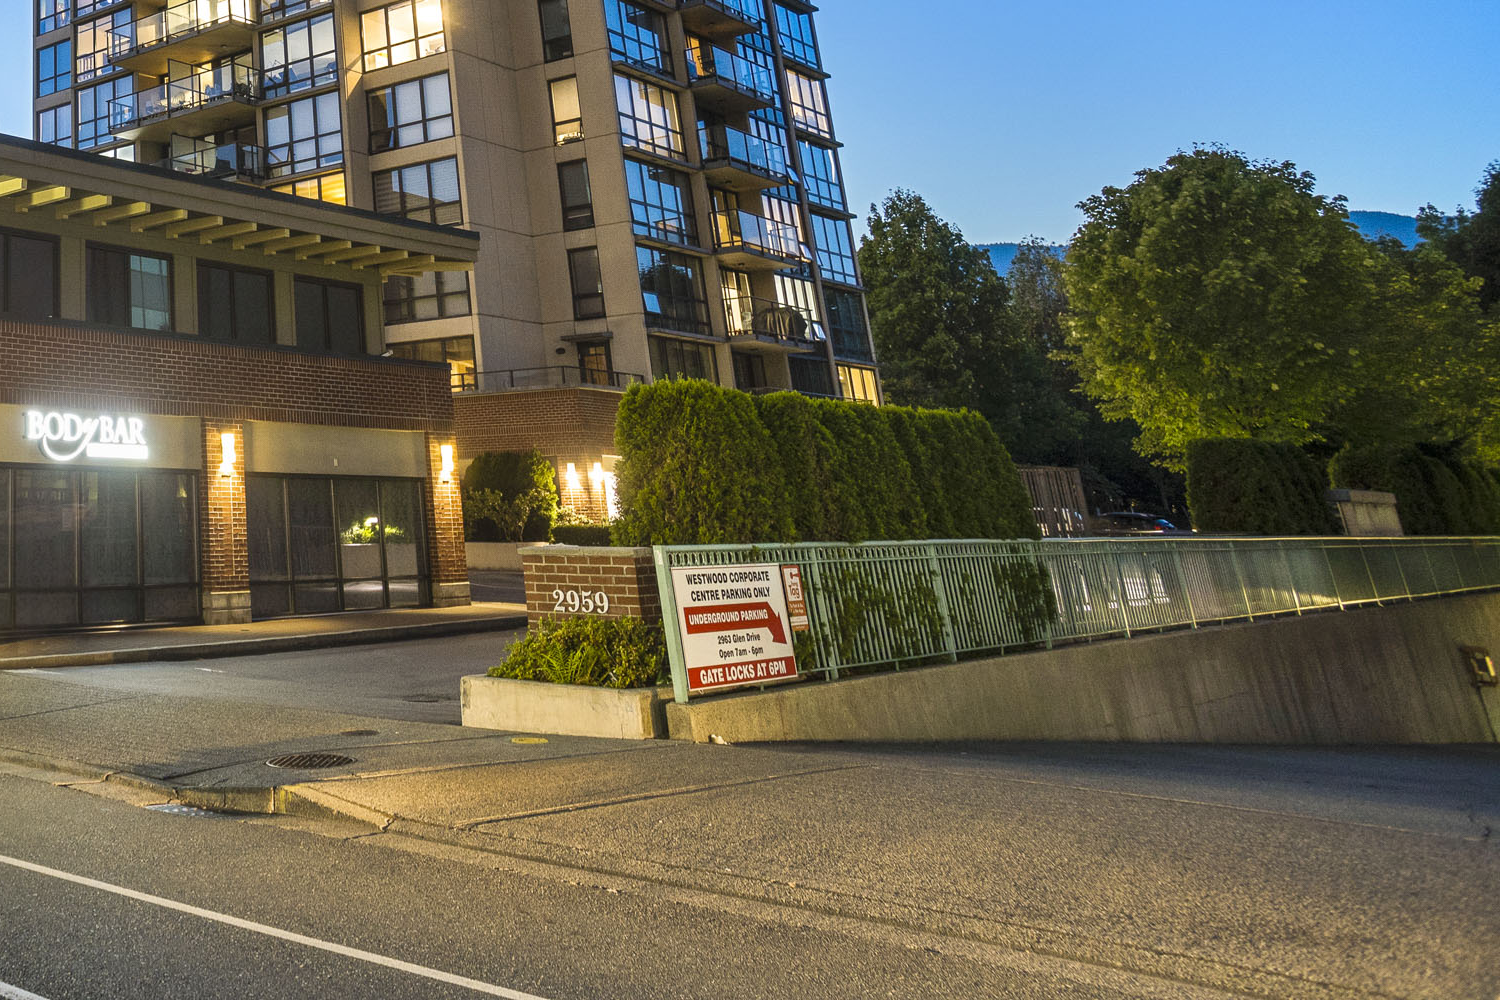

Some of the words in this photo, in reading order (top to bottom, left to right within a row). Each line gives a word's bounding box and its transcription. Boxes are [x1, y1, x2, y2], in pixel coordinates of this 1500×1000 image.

[685, 572, 728, 585] WESTWOOD
[729, 571, 770, 583] CORPORATE
[552, 589, 609, 614] 2959
[690, 589, 720, 602] CENTRE
[721, 588, 752, 600] PARKING
[753, 587, 770, 598] ONLY
[688, 610, 740, 625] UNDERGROUND
[740, 609, 768, 620] PARKING
[717, 635, 732, 645] 2963
[732, 634, 745, 644] Glen
[746, 632, 760, 642] Drive
[719, 649, 734, 660] Open
[735, 648, 747, 657] 7am
[751, 646, 763, 656] 6pm
[700, 667, 724, 684] GATE
[725, 664, 755, 681] LOCKS
[757, 663, 767, 677] AT
[769, 660, 786, 676] 6PM
